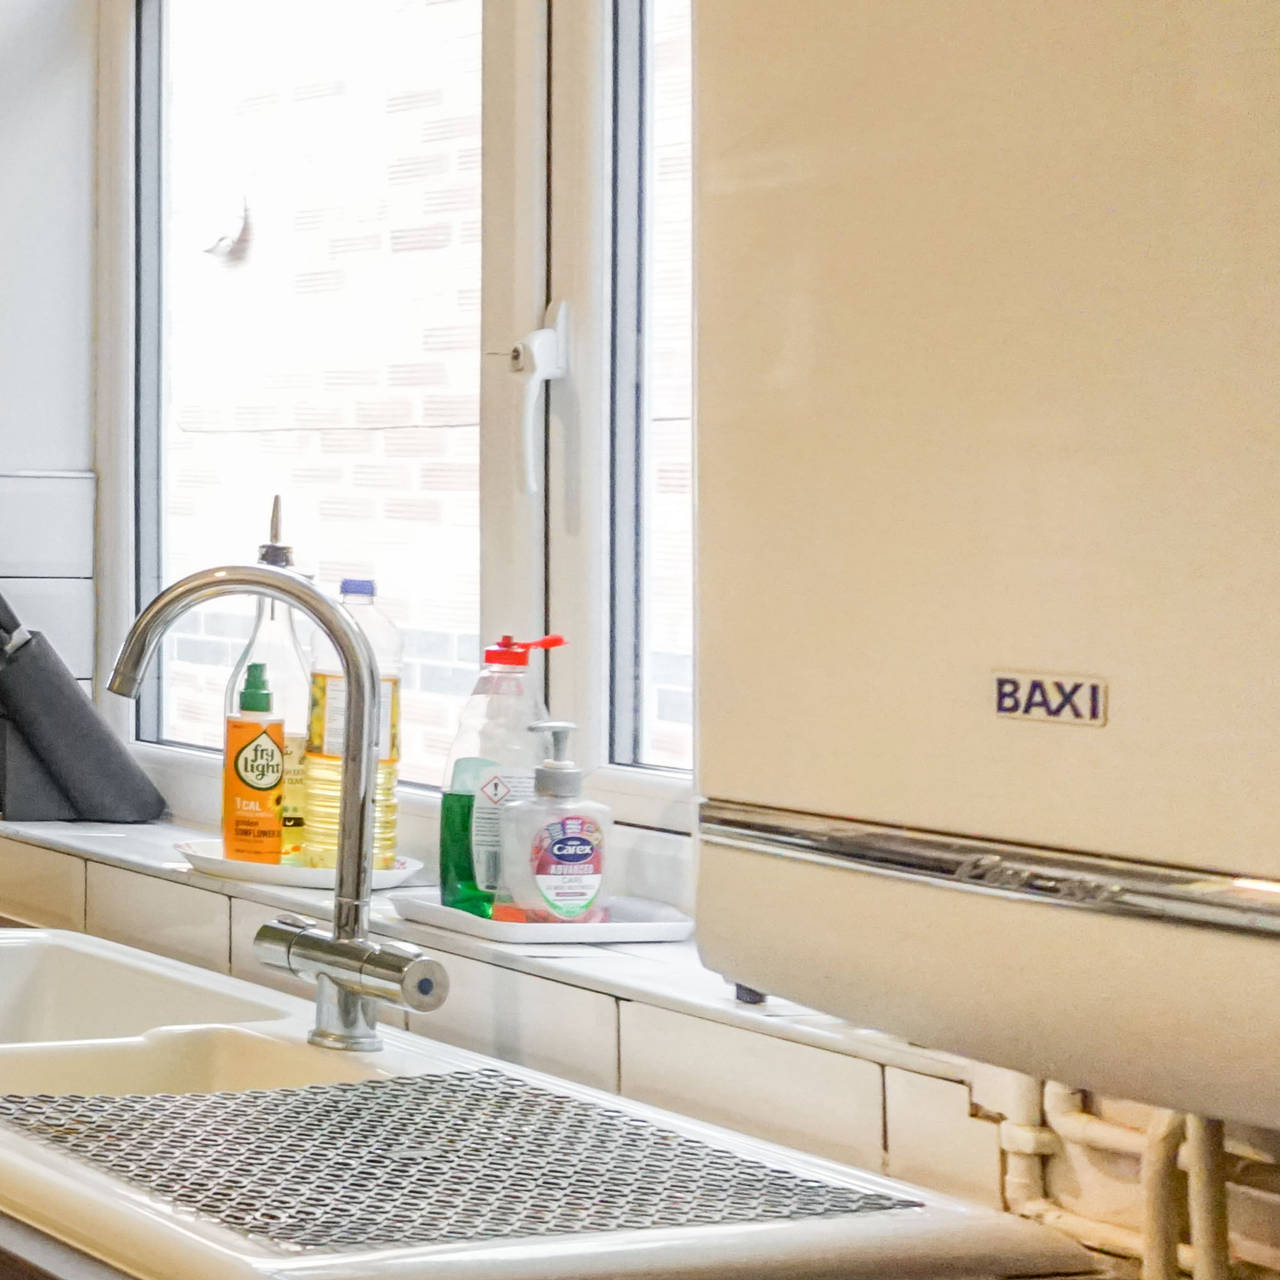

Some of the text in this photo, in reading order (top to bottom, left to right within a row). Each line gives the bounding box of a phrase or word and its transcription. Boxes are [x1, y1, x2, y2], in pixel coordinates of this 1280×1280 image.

[996, 677, 1100, 721] BAXI
[251, 743, 275, 764] fry
[243, 757, 281, 780] light
[552, 844, 593, 856] Carex
[550, 863, 594, 874] ADVANCED
